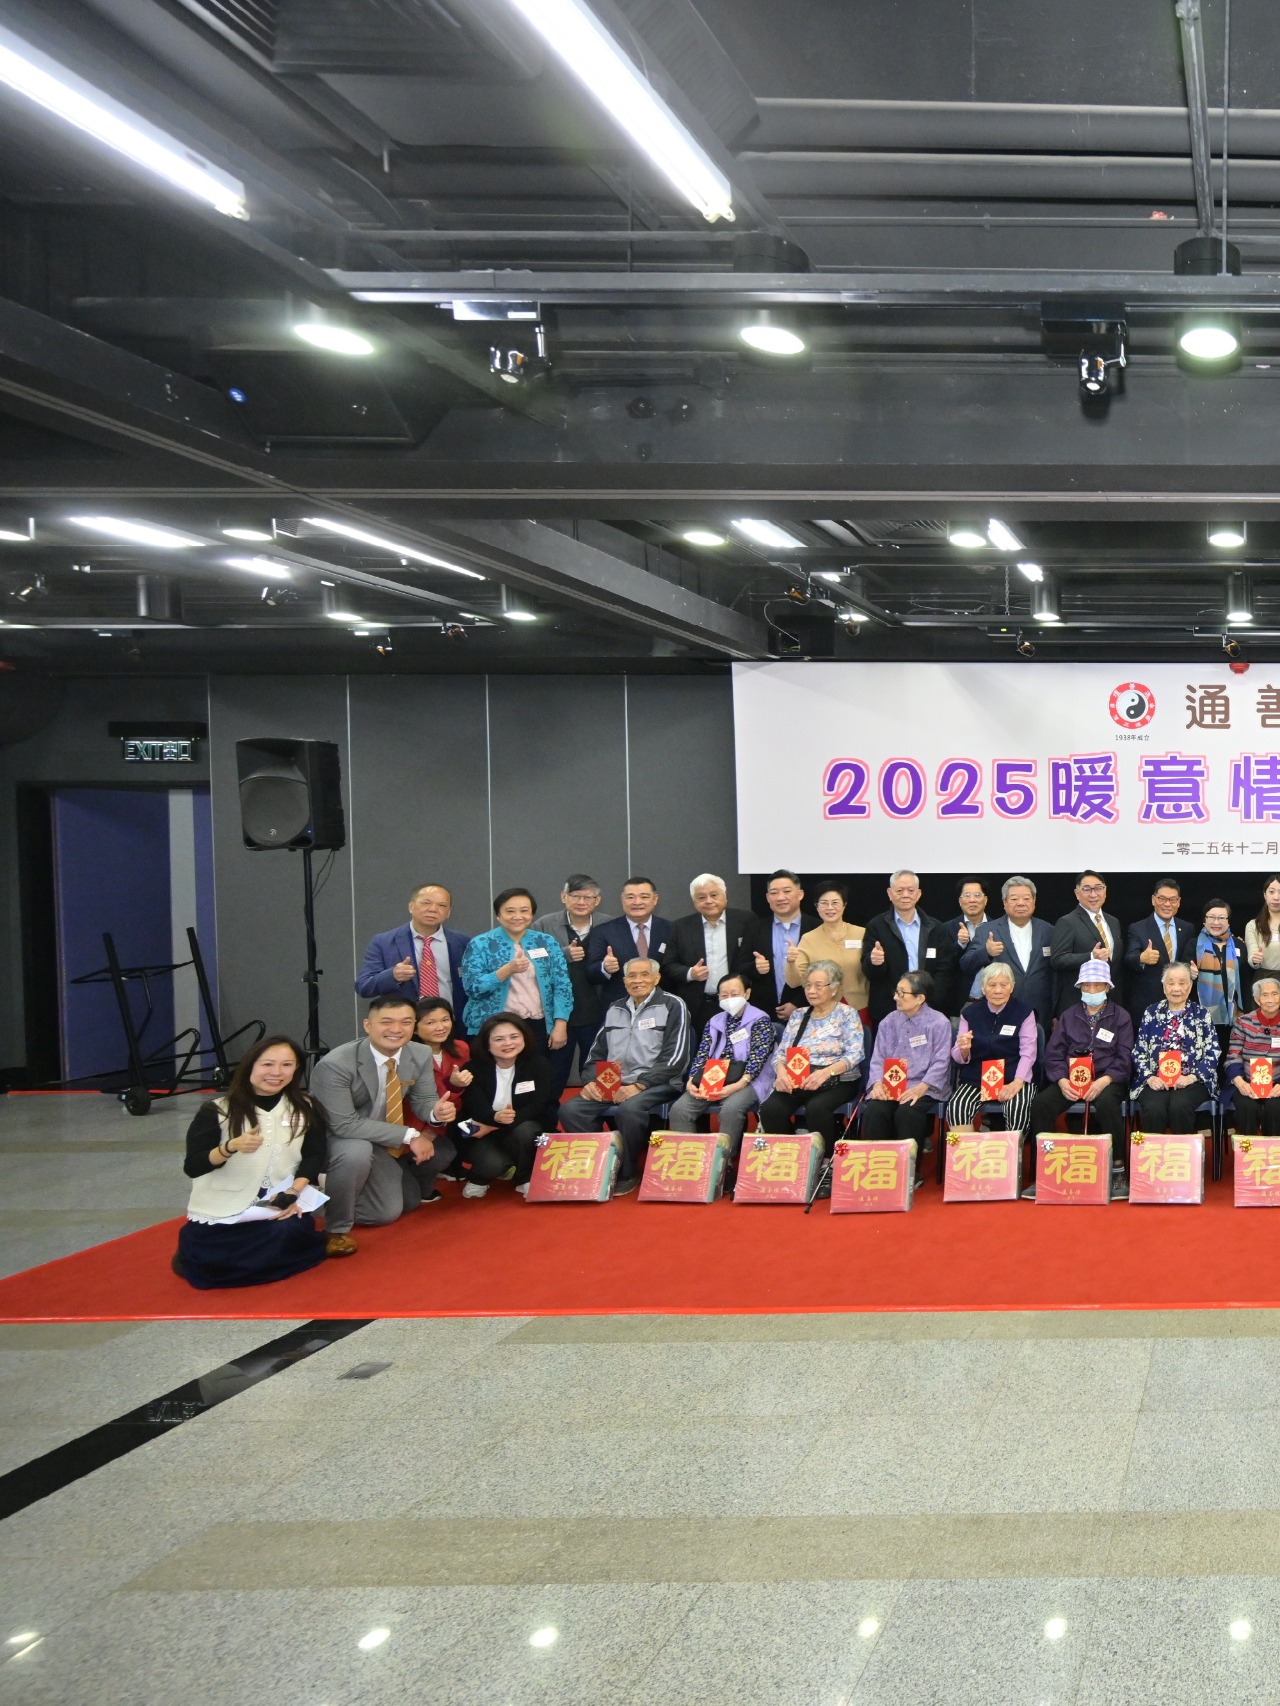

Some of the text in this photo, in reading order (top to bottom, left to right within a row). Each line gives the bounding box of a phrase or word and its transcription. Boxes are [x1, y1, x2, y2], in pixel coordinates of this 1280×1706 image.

[124, 740, 162, 760] EXIT
[888, 1069, 901, 1082] 福
[541, 1140, 599, 1179] 福
[651, 1141, 704, 1181] 福
[746, 1143, 801, 1182] 福
[841, 1149, 897, 1191] 福
[953, 1140, 1009, 1180] 福
[1044, 1145, 1097, 1184] 福
[1138, 1143, 1190, 1182] 福
